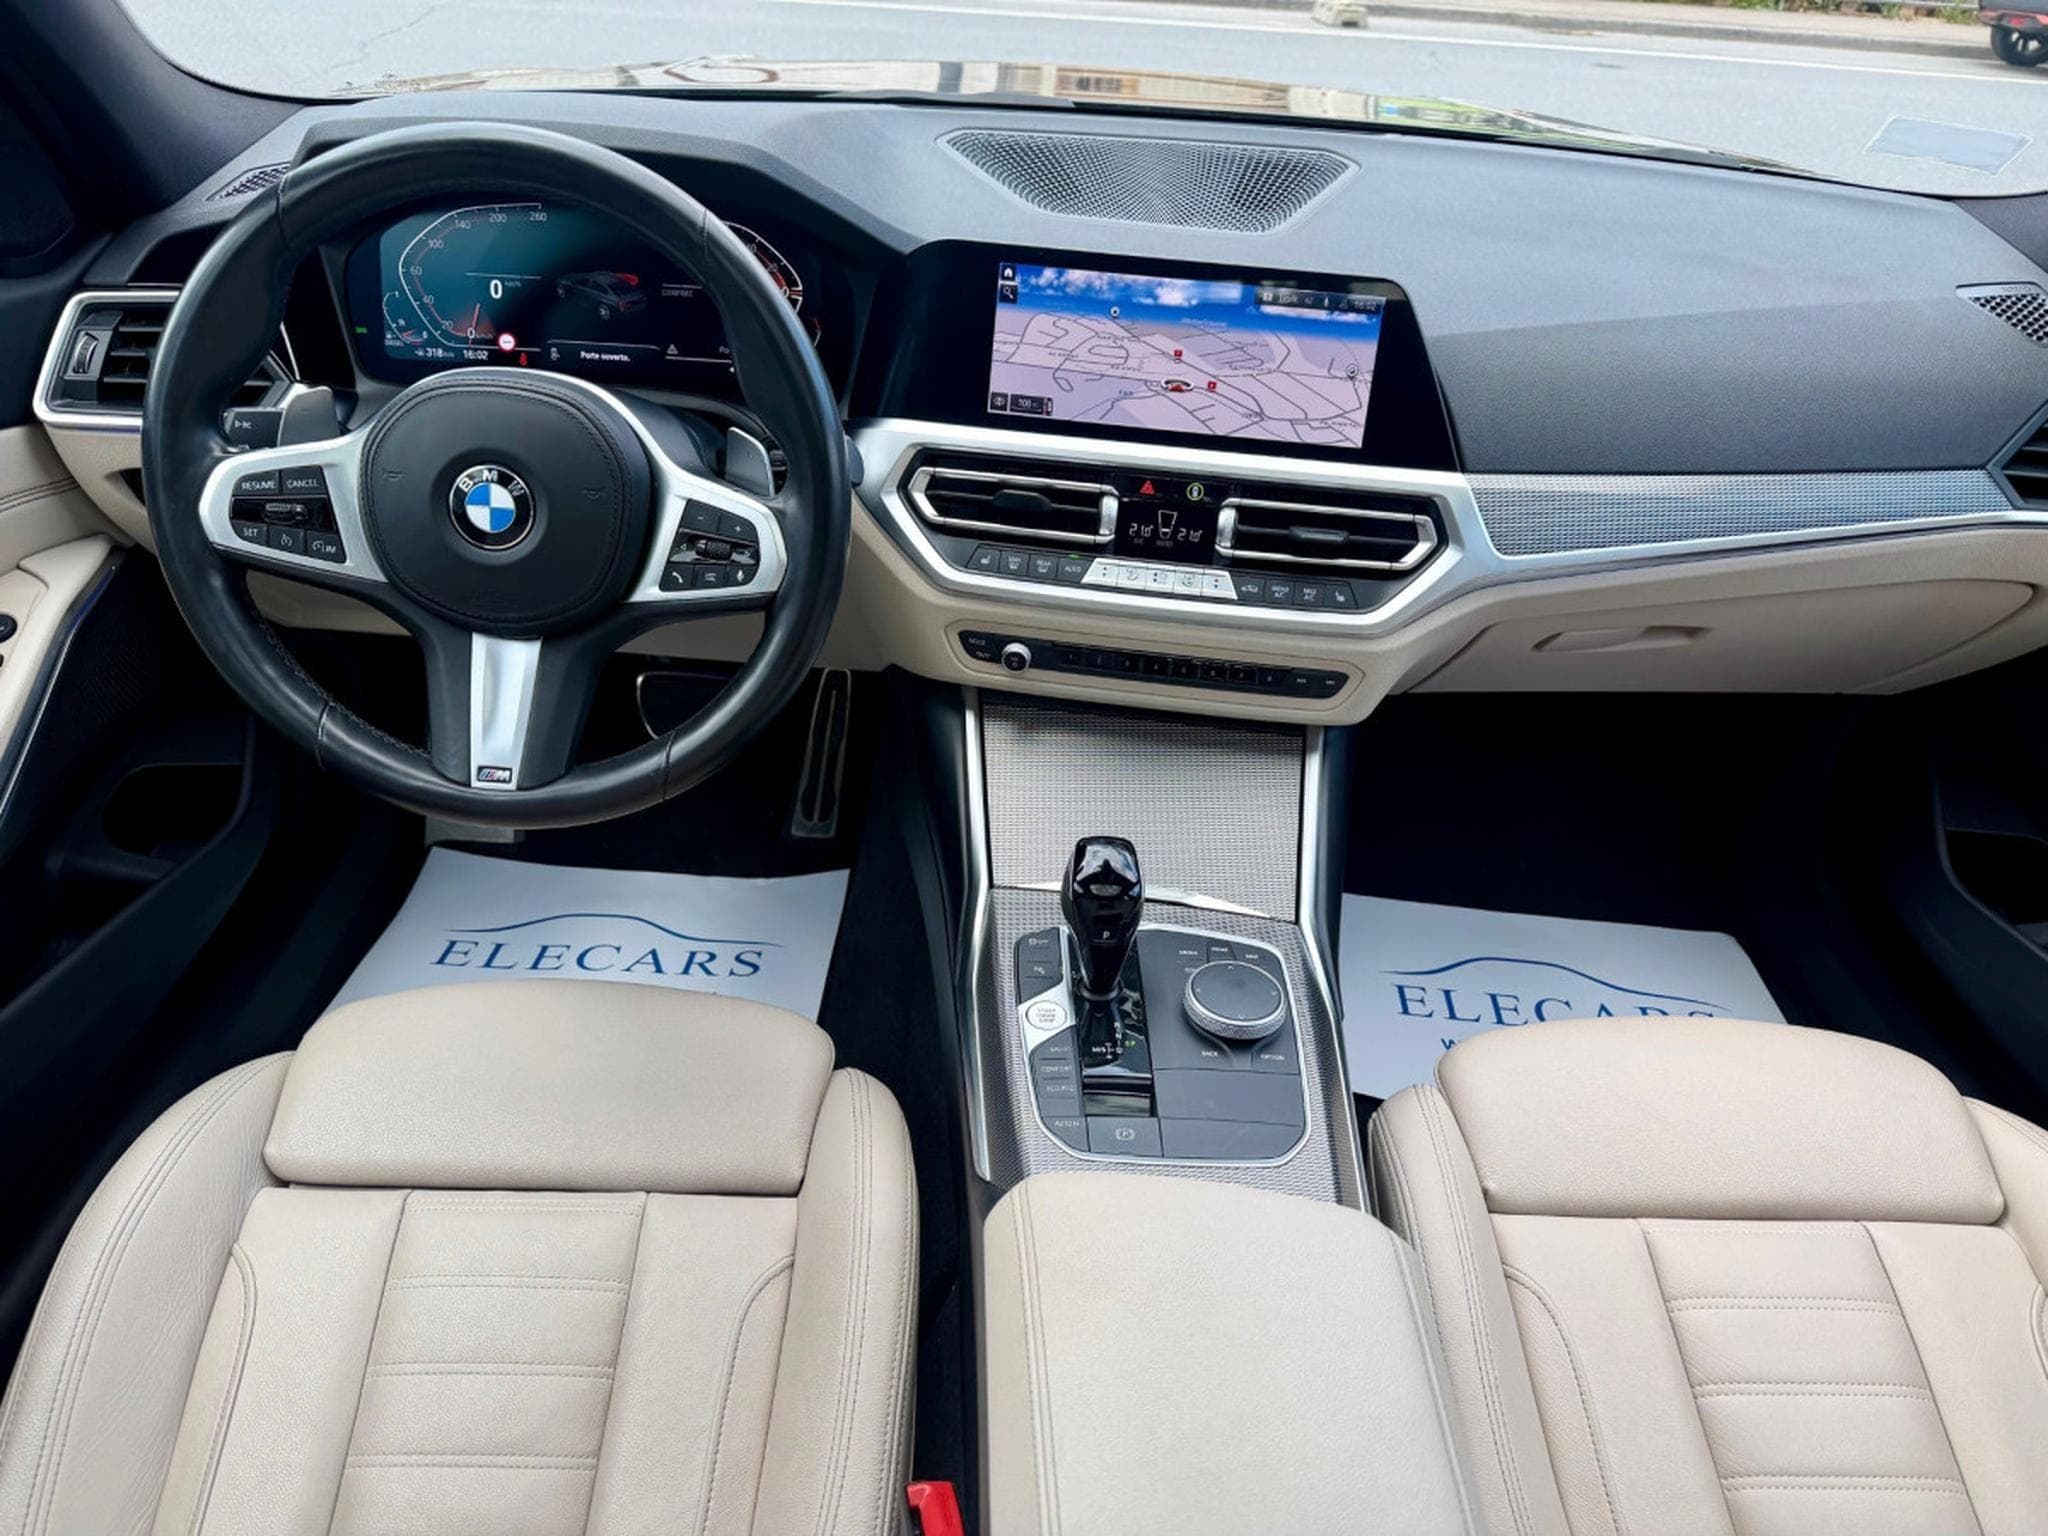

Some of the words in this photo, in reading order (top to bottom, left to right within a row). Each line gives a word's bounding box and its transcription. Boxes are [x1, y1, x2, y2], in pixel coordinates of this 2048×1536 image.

[489, 213, 507, 223] 200
[529, 211, 547, 222] 260
[454, 219, 472, 230] 140
[428, 239, 445, 249] 100
[410, 266, 423, 276] 60
[490, 279, 503, 300] 0
[423, 295, 435, 305] 40
[441, 320, 453, 330] 20
[426, 348, 443, 358] 318
[463, 350, 489, 360] 16:02
[580, 351, 600, 360] Porte
[241, 480, 276, 490] RESUME
[286, 479, 319, 489] CANCEL
[459, 469, 524, 496] BMW
[243, 528, 258, 537] SET
[429, 938, 764, 978] ELECARS
[1393, 983, 1714, 1028] ELEC
